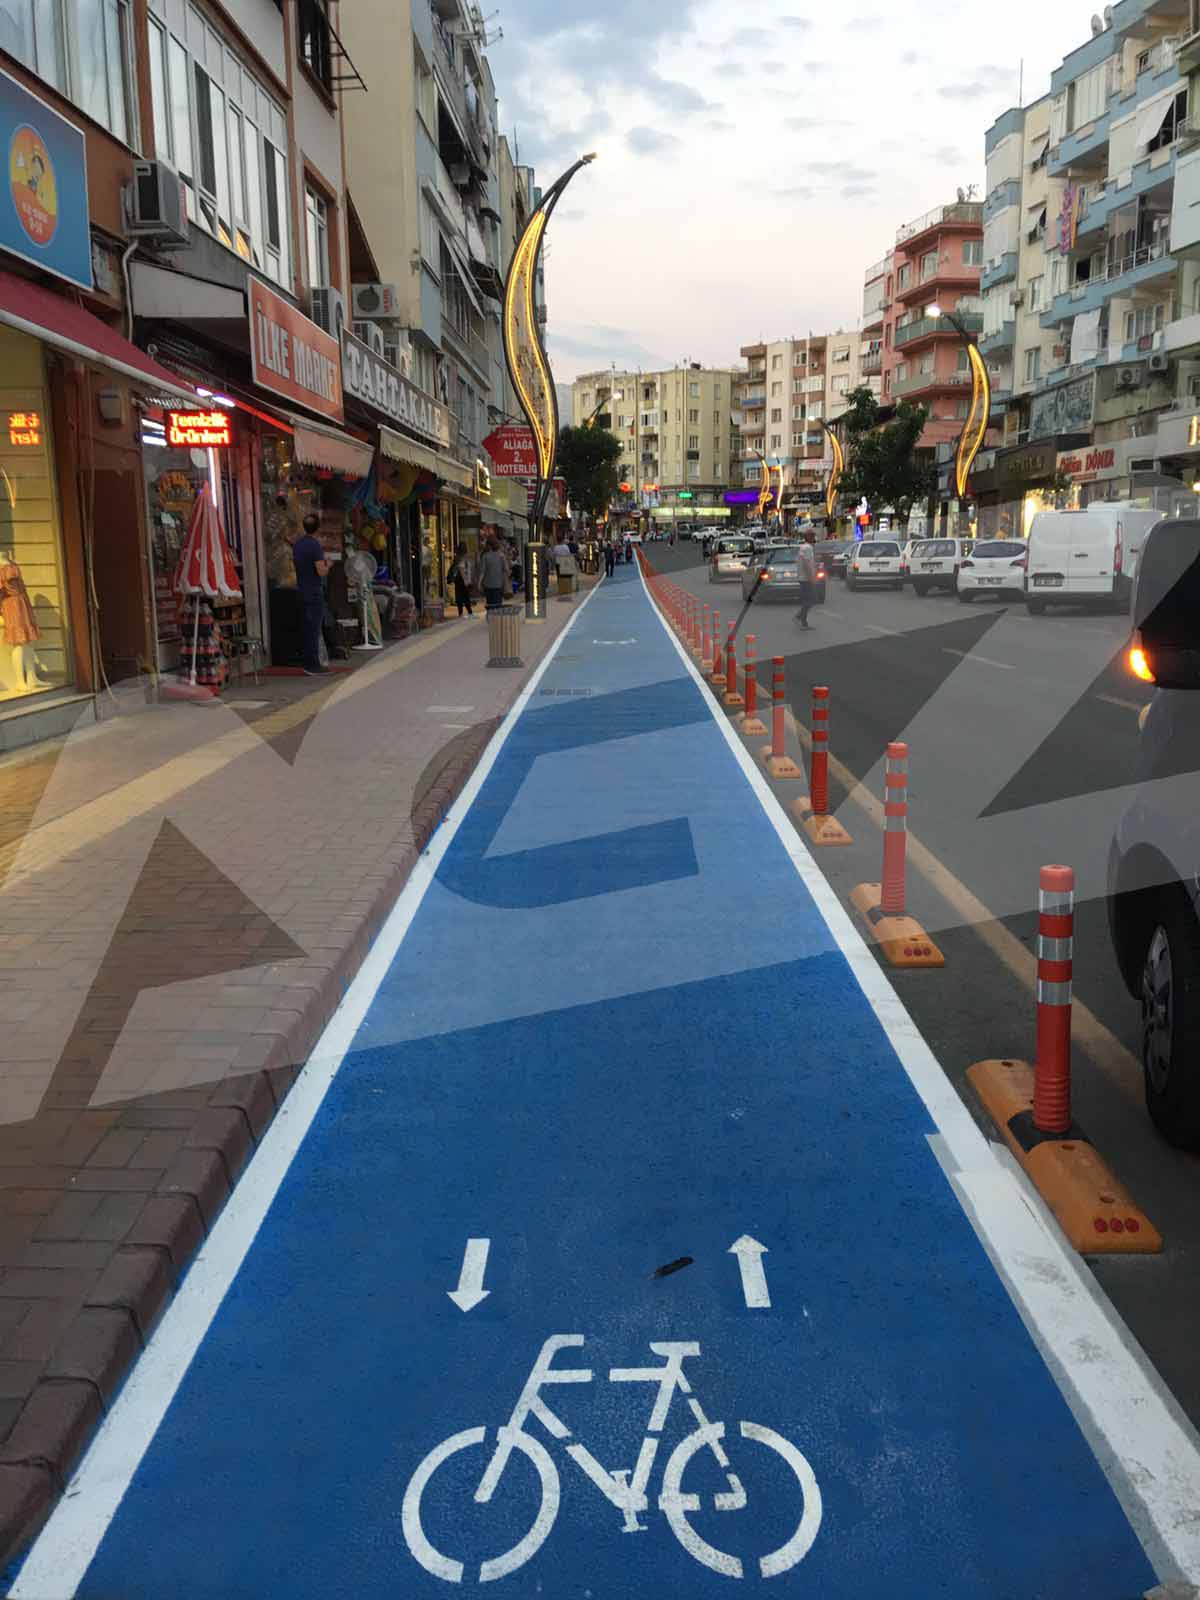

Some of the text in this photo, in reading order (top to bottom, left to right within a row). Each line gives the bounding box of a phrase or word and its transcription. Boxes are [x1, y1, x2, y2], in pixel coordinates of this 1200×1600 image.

[256, 300, 291, 380] İLKE
[345, 340, 444, 440] TAHTAKALE
[497, 461, 537, 473] NOTERLİĞ
[513, 451, 523, 462] 2.
